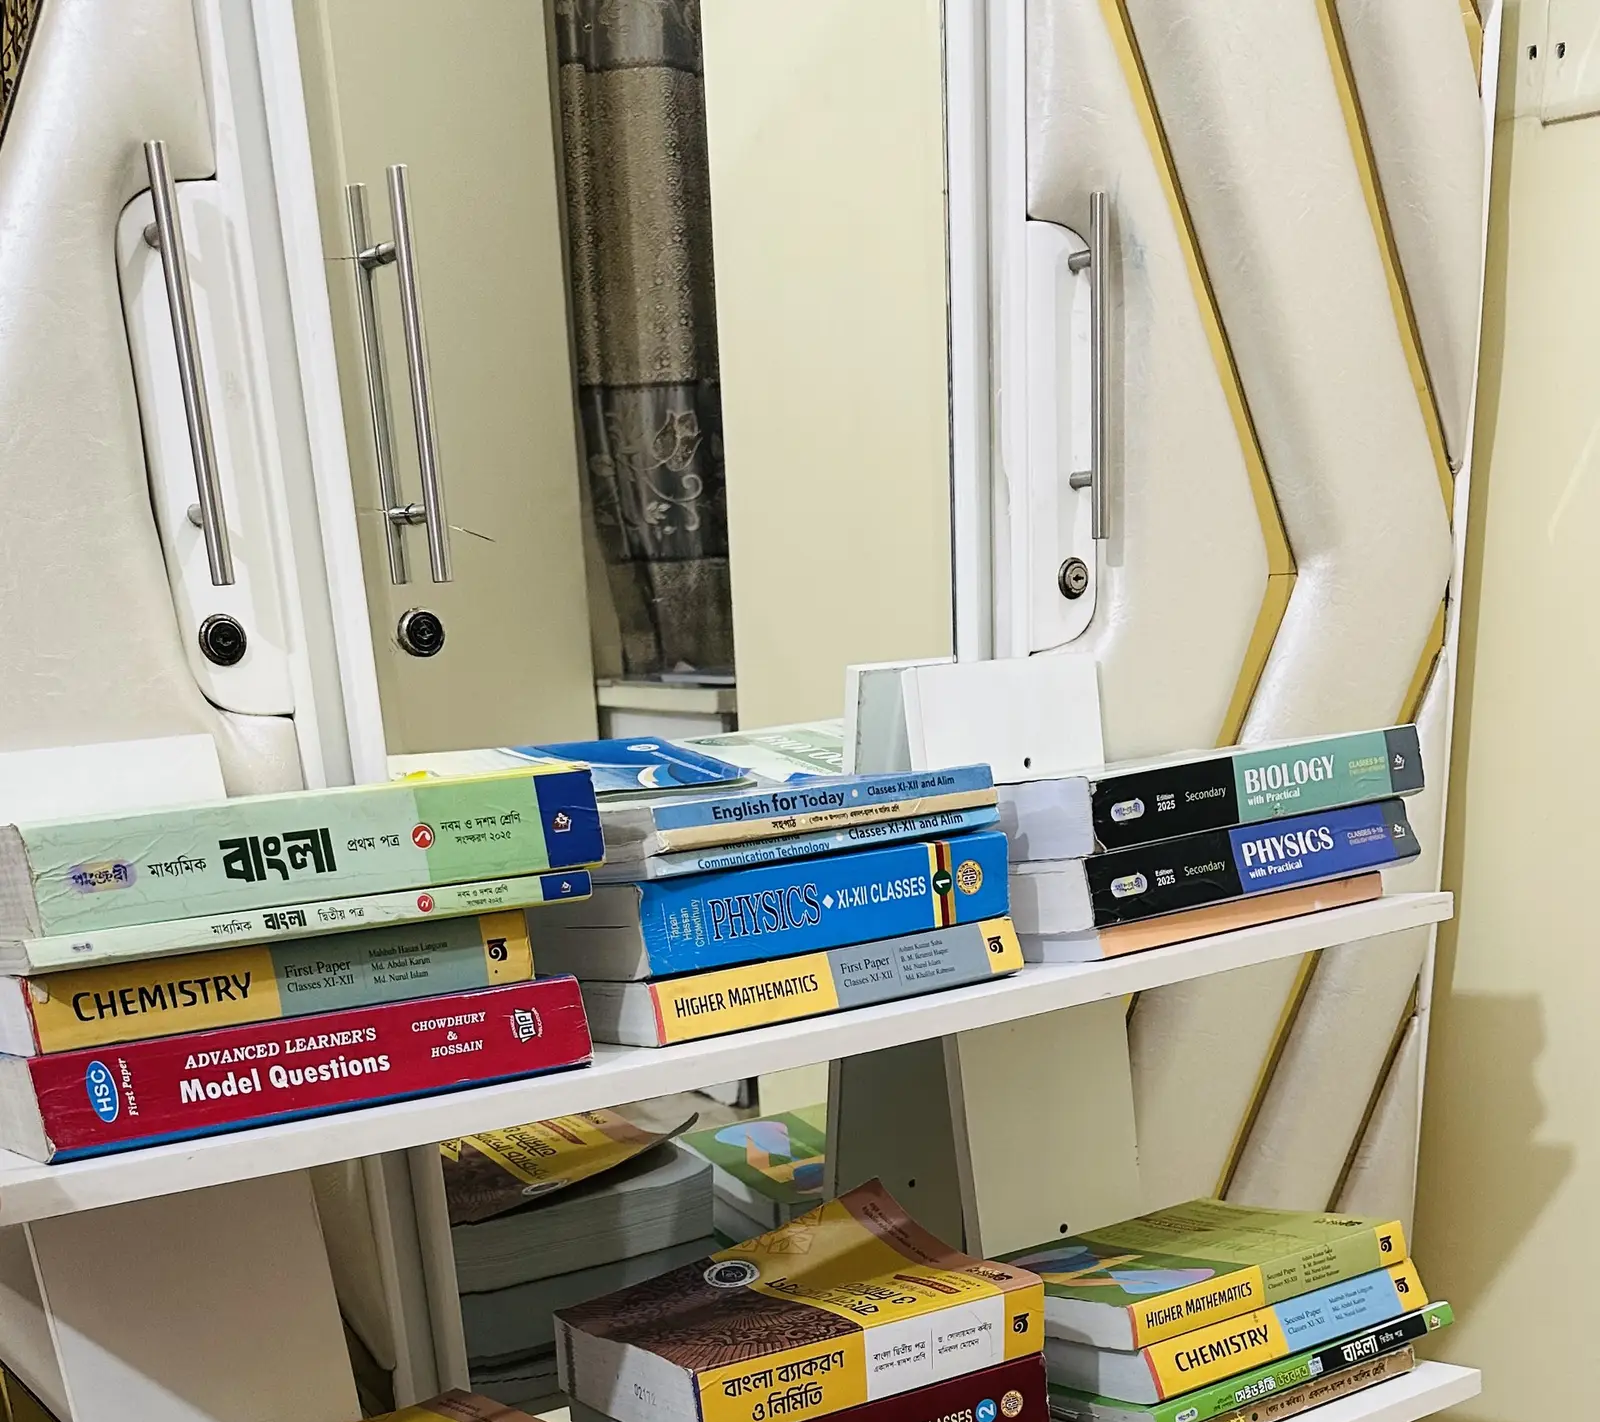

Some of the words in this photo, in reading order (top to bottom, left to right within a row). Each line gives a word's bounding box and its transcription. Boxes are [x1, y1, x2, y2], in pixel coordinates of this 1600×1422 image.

[867, 785, 895, 796] Classes
[897, 781, 918, 792] XI-XII
[921, 779, 935, 789] and
[937, 776, 954, 786] Alim
[1244, 754, 1335, 794] BIOLOGY
[712, 800, 769, 821] English
[772, 792, 797, 811] for
[800, 790, 845, 808] Today
[1157, 801, 1176, 812] 2025
[1184, 786, 1227, 803] Secondary
[1247, 795, 1265, 806] with
[1266, 787, 1300, 802] Practical
[440, 820, 461, 831] নবম
[466, 819, 473, 829] ও
[476, 816, 496, 829] দশম
[500, 811, 521, 826] শ্রেণি
[849, 826, 886, 840] Classes
[889, 822, 916, 835] XI-XII
[919, 818, 938, 830] and
[940, 813, 964, 827] Alim
[455, 833, 486, 845] সংস্করণ
[490, 831, 512, 842] ২০২৫
[1241, 826, 1334, 867] PHYSICS
[147, 855, 207, 878] মাধ্যমিক
[219, 827, 337, 883] বাংলা
[347, 834, 375, 852] প্রথম
[380, 834, 400, 848] পত্র
[697, 851, 775, 870] Communication
[777, 842, 830, 859] Technology
[1184, 860, 1225, 877] Secondary
[1249, 869, 1267, 879] with
[1268, 859, 1303, 875] Practical
[1156, 875, 1176, 887] 2025
[211, 920, 252, 935] মাধ্যমিক
[263, 909, 307, 930] বাংলা
[317, 908, 345, 924] দ্বিতীয়
[349, 907, 365, 918] পত্র
[709, 883, 821, 940] PHYSICS
[836, 885, 868, 910] XI-XII
[870, 876, 926, 902] CLASSES
[285, 964, 313, 979] First
[317, 960, 351, 976] Paper
[840, 960, 862, 974] First
[864, 956, 890, 973] Paper
[72, 971, 251, 1022] CHEMISTRY
[287, 980, 322, 993] Classes
[324, 974, 354, 988] XI-XII
[674, 990, 725, 1018] HIGHER
[728, 974, 818, 1008] MATHEMATICS
[411, 1012, 486, 1032] CHOWDHURY
[447, 1030, 458, 1042] &
[185, 1042, 280, 1070] ADVANCED
[286, 1027, 377, 1054] LEARNER'S
[431, 1040, 483, 1058] HOSSAIN
[118, 1058, 133, 1089] Paper
[180, 1067, 262, 1104] Model
[269, 1054, 391, 1089] Questions
[91, 1069, 114, 1112] HSC
[128, 1088, 139, 1116] First
[1146, 1304, 1183, 1328] HIGHER
[1185, 1282, 1253, 1316] MATHEMATICS
[1175, 1324, 1269, 1372] CHEMISTRY
[723, 1370, 774, 1398] বাংলা
[776, 1350, 844, 1382] ব্যাকরণ
[752, 1403, 765, 1422] ও
[767, 1382, 823, 1418] নির্মিতি
